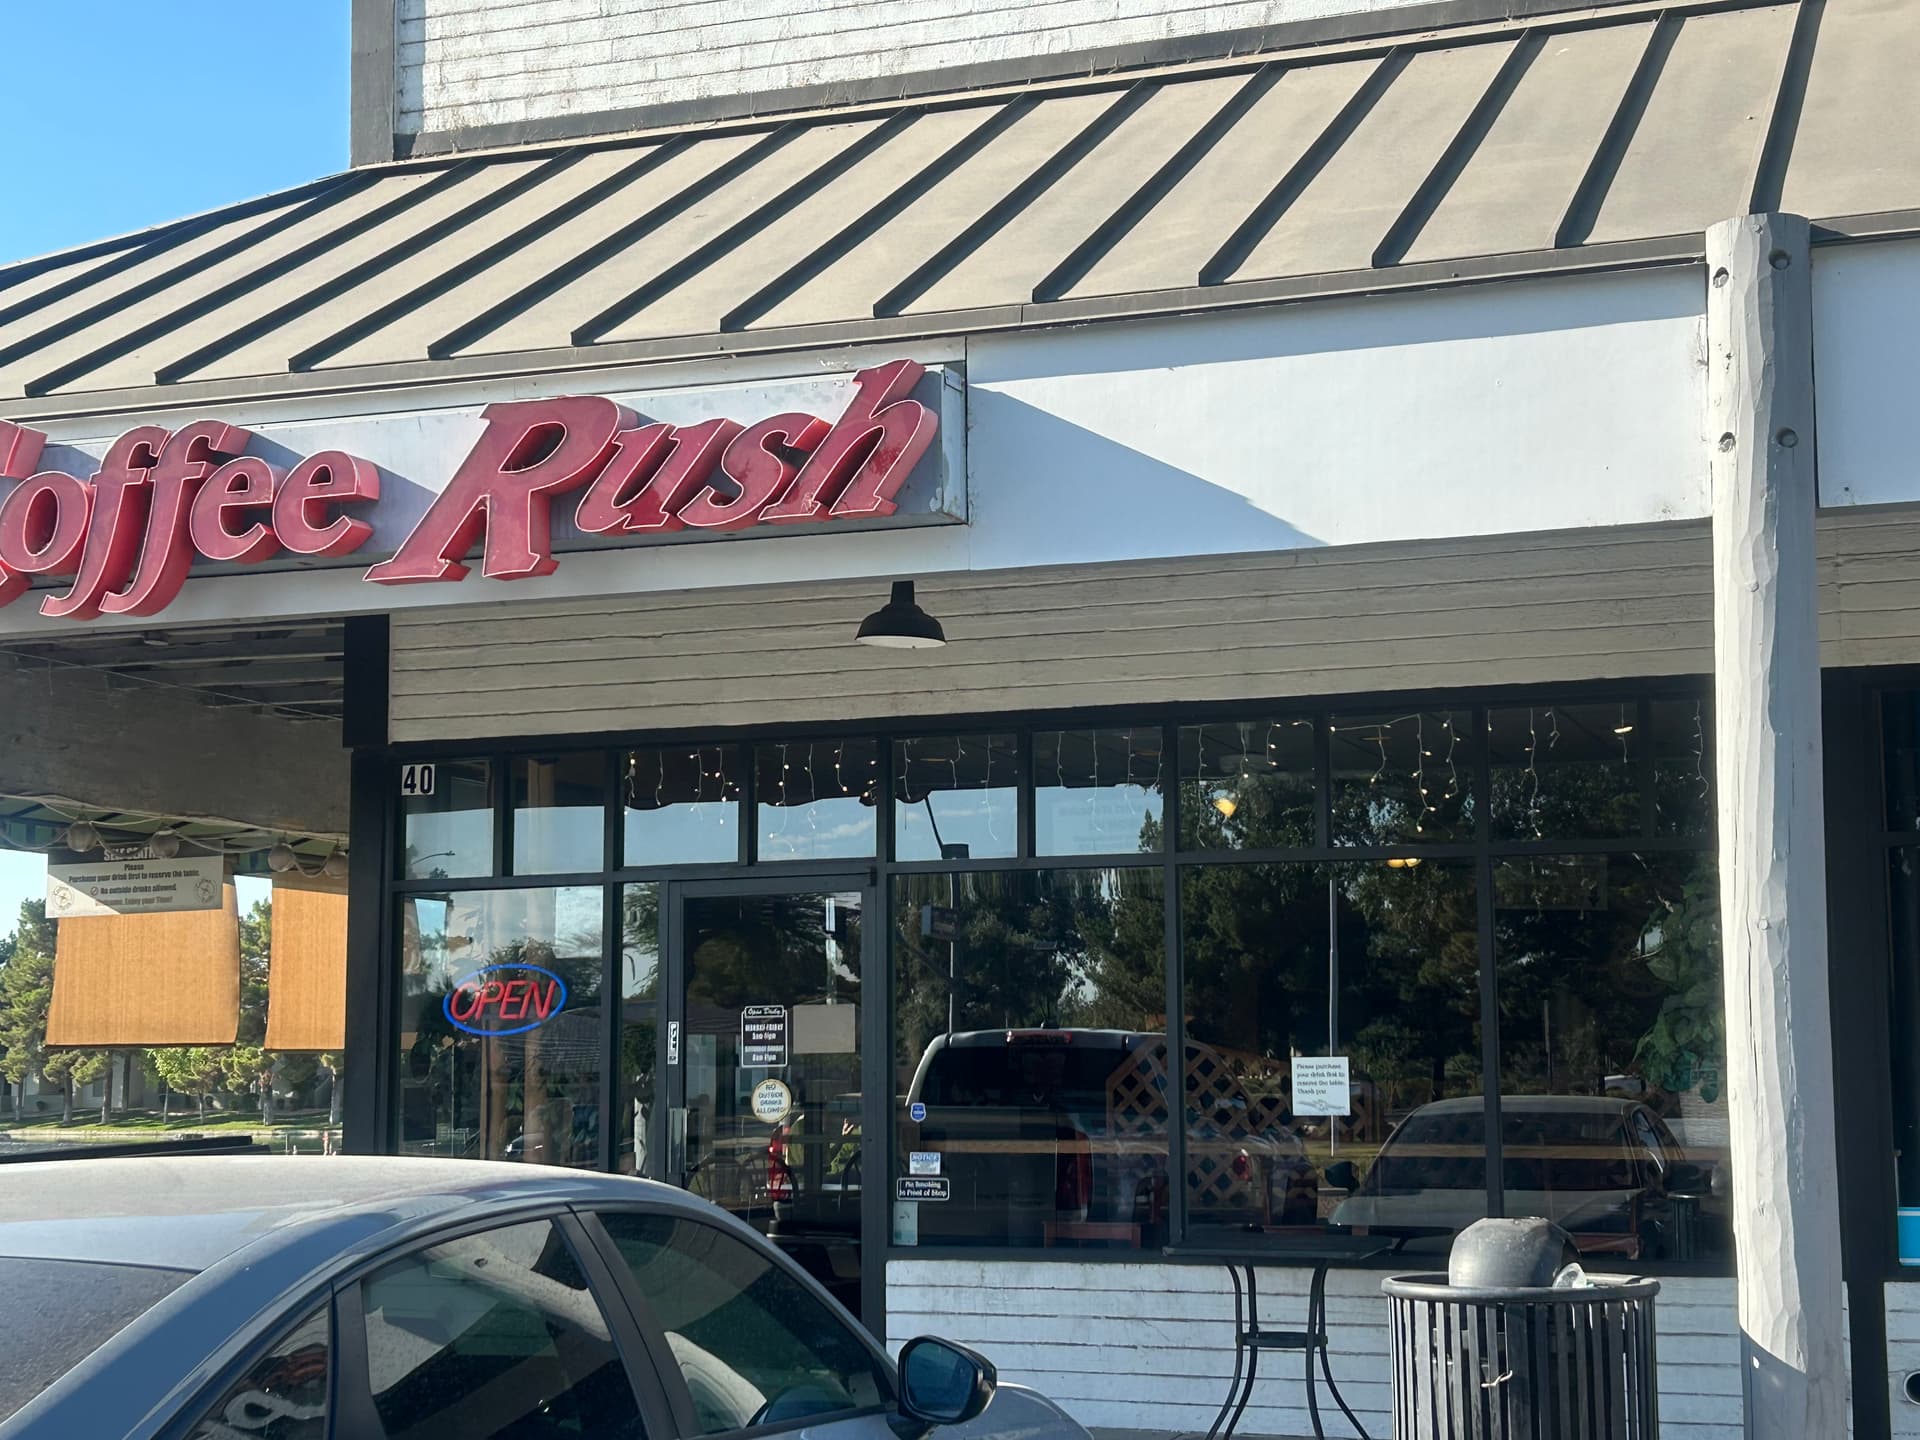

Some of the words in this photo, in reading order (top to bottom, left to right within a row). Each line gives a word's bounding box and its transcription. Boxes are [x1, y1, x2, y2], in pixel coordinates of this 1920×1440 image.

[362, 358, 939, 586] Rush
[403, 765, 433, 794] 40
[148, 871, 172, 879] reserve
[450, 980, 557, 1021] OPEN
